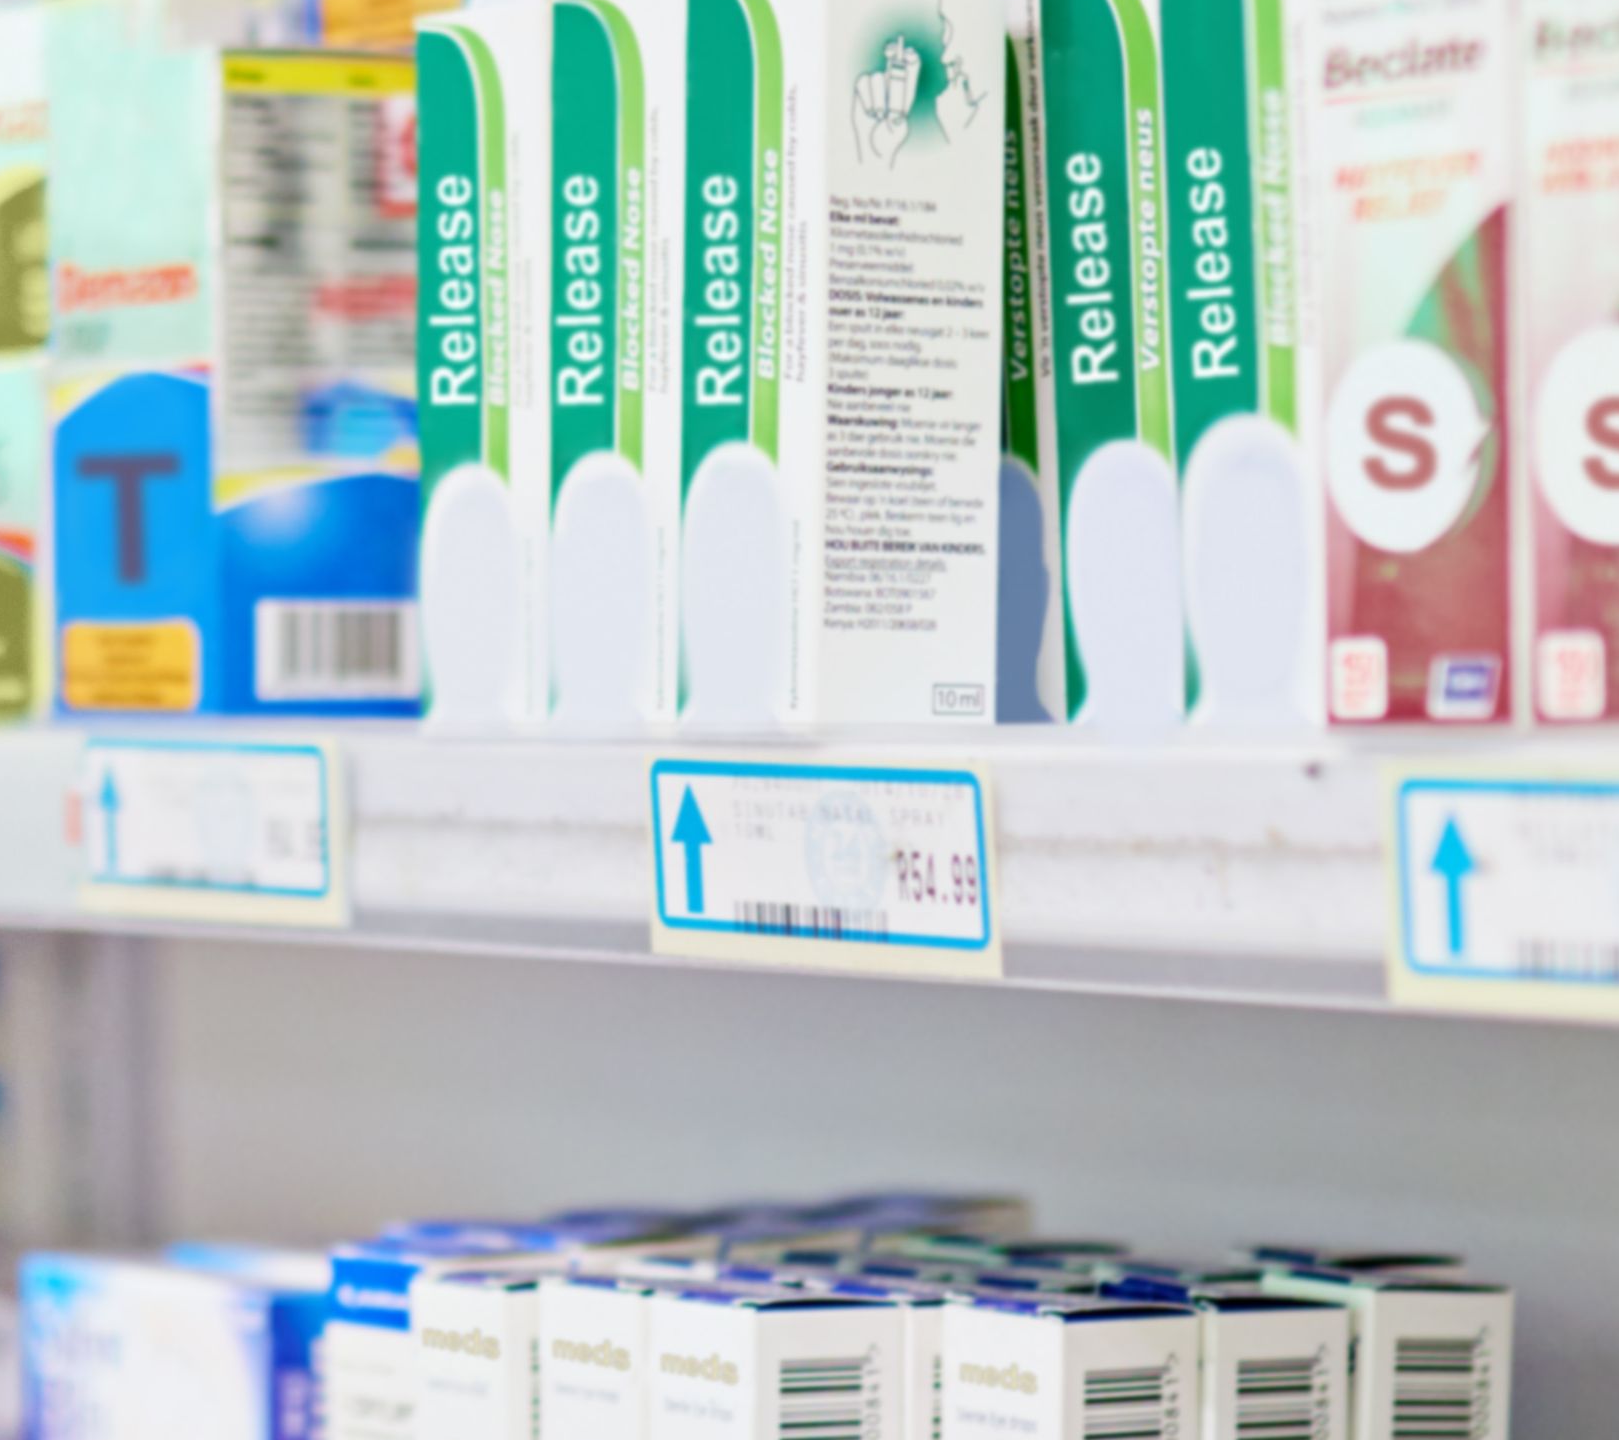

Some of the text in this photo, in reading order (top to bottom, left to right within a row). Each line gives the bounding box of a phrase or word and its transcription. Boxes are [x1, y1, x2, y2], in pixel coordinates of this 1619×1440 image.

[1323, 35, 1485, 93] Beclate
[428, 174, 478, 407] Release
[484, 189, 506, 407] Blocked Nose
[555, 174, 604, 407] Release
[620, 167, 642, 392] Blocked Nose
[694, 174, 743, 407] Release
[755, 149, 778, 380] Blocked Nose
[1004, 219, 1028, 381] Verstopte
[1064, 152, 1120, 385] Release
[1134, 109, 1162, 371] Verstopte neus
[1185, 147, 1240, 380] Release
[75, 453, 181, 586] T
[1362, 393, 1439, 492] S
[896, 849, 978, 906] R54.99
[422, 1325, 501, 1360] meds
[552, 1335, 631, 1372] meds
[660, 1350, 739, 1386] meds
[959, 1361, 1039, 1396] meds
